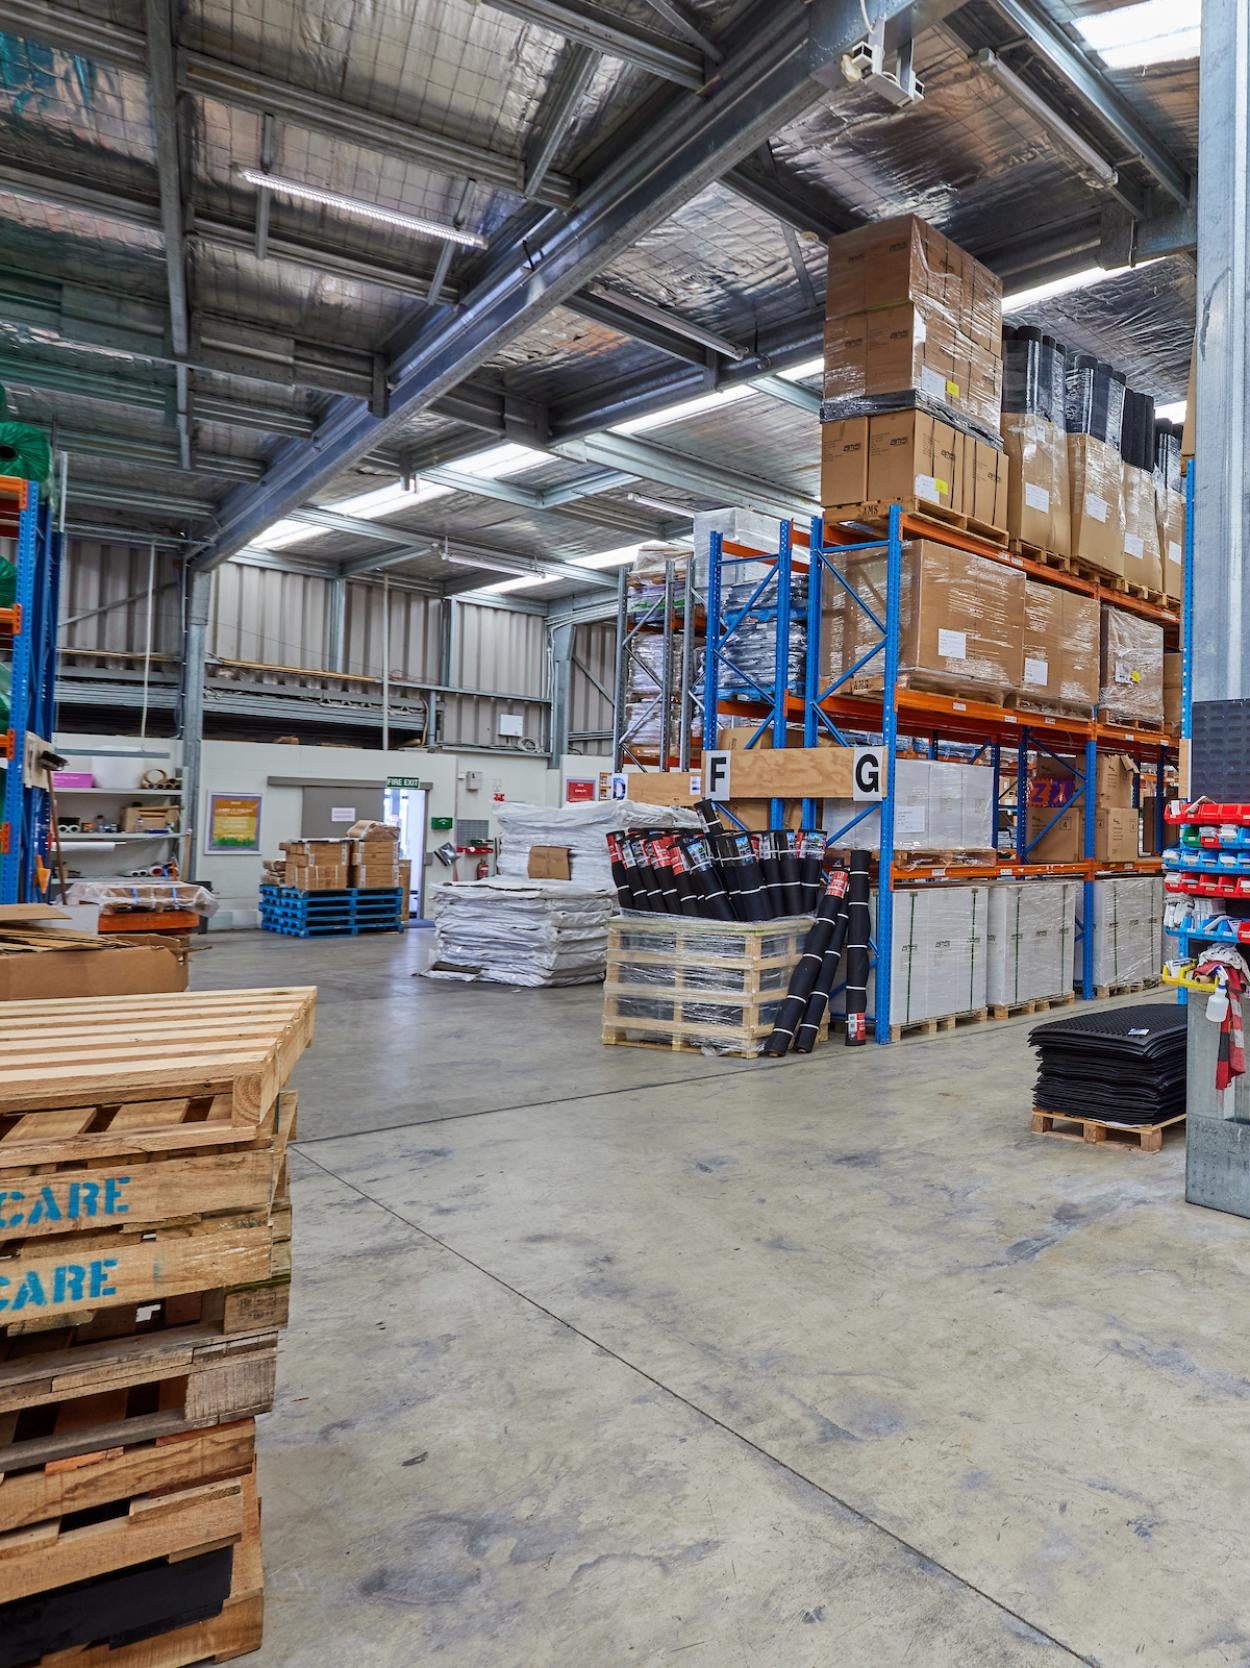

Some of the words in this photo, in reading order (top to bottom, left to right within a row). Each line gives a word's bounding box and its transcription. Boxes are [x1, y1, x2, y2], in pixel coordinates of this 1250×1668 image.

[387, 777, 402, 786] FIRE
[403, 778, 418, 787] EXIT
[612, 777, 627, 800] D
[710, 757, 728, 793] F
[855, 753, 880, 793] G
[0, 1176, 131, 1229] CARE
